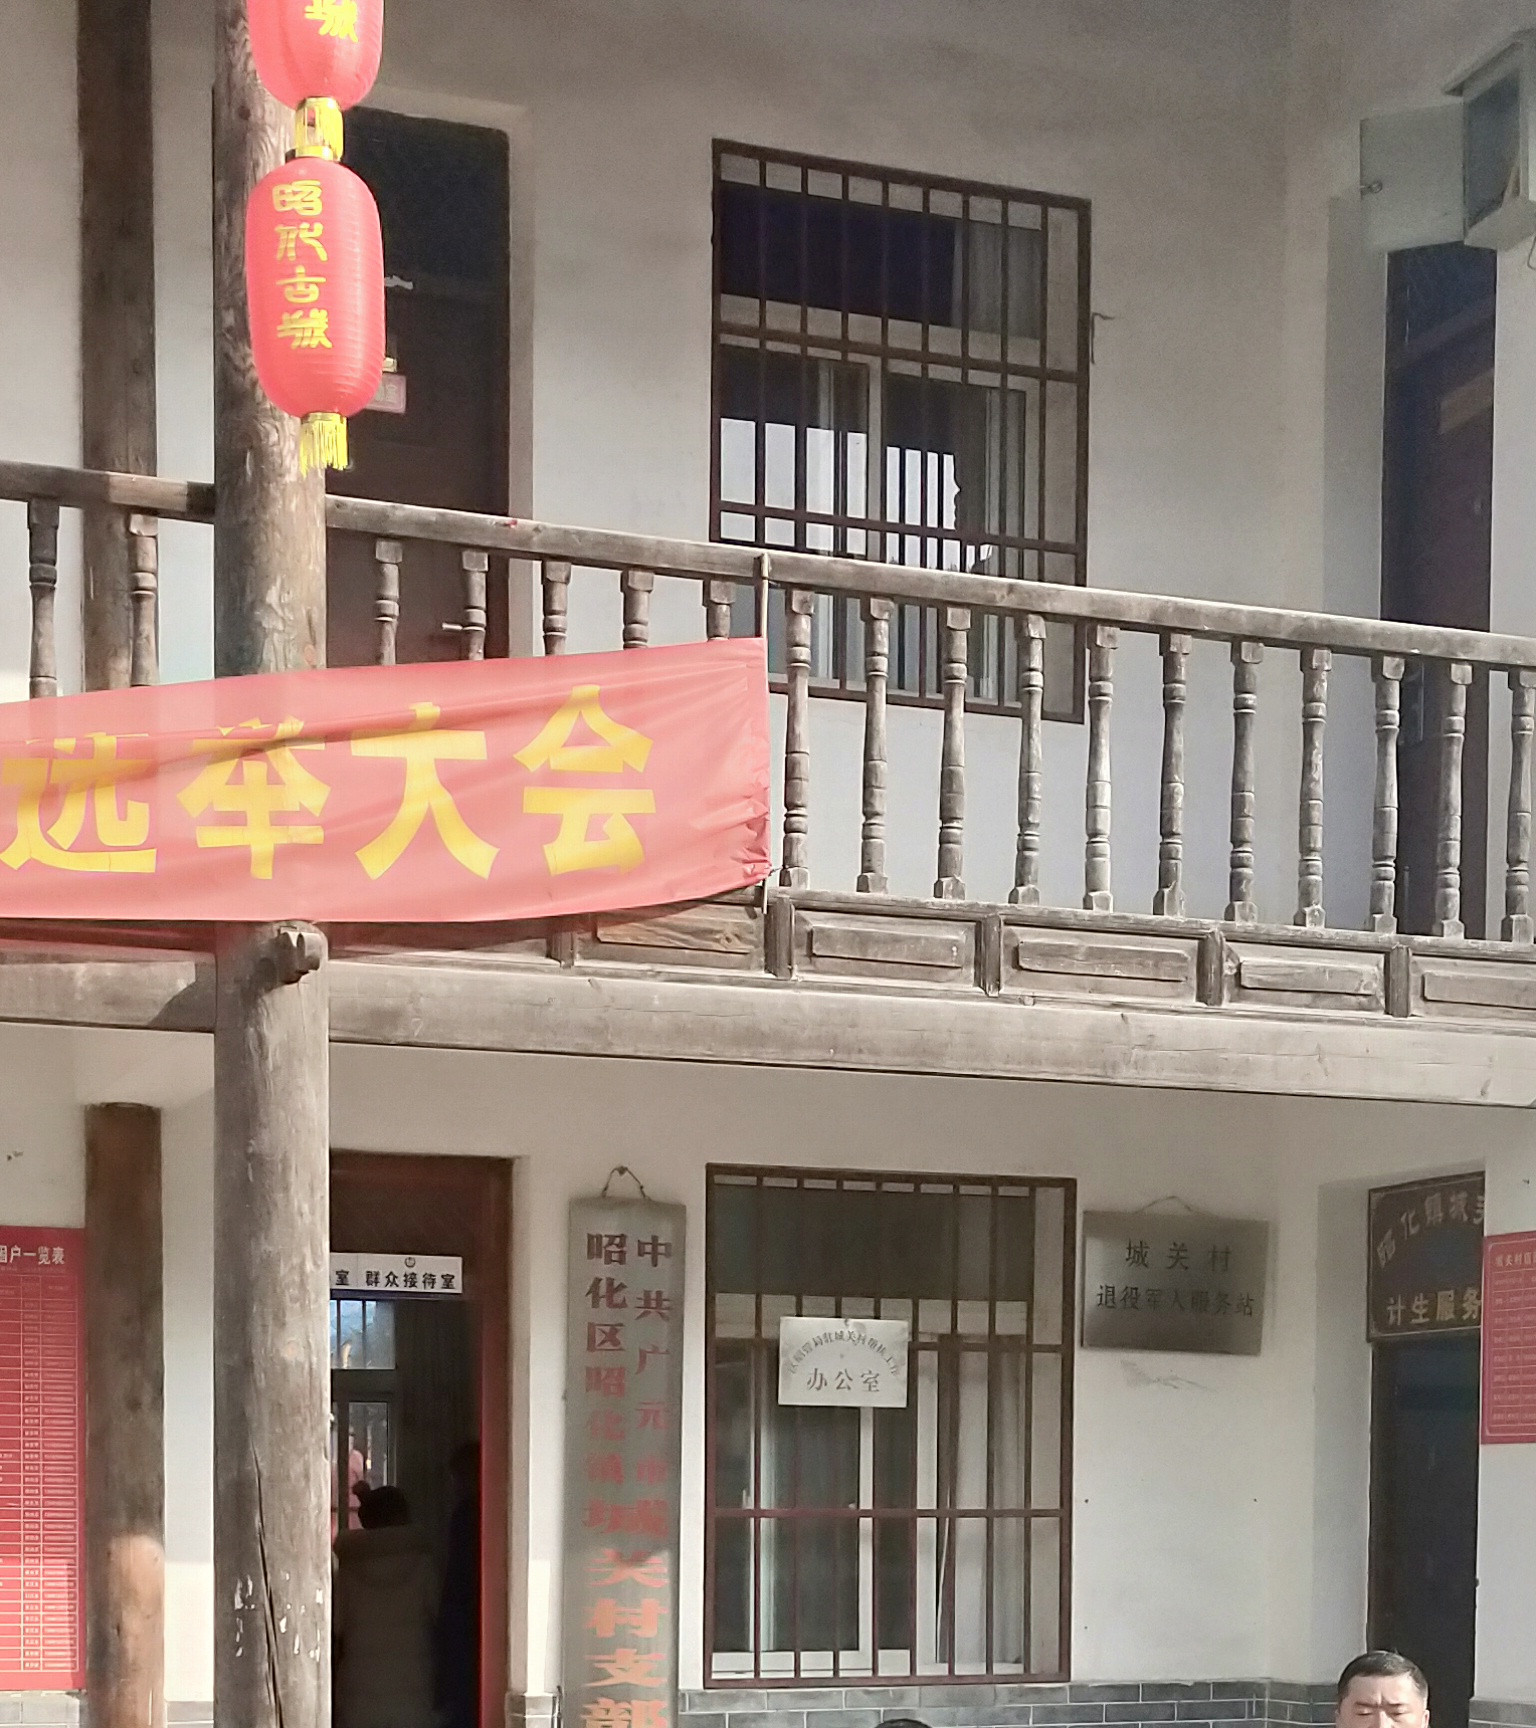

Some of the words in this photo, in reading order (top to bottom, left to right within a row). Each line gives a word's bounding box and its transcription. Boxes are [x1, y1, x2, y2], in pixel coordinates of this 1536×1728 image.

[365, 1269, 457, 1290] 群众接待室
[806, 1367, 880, 1393] 办公室
